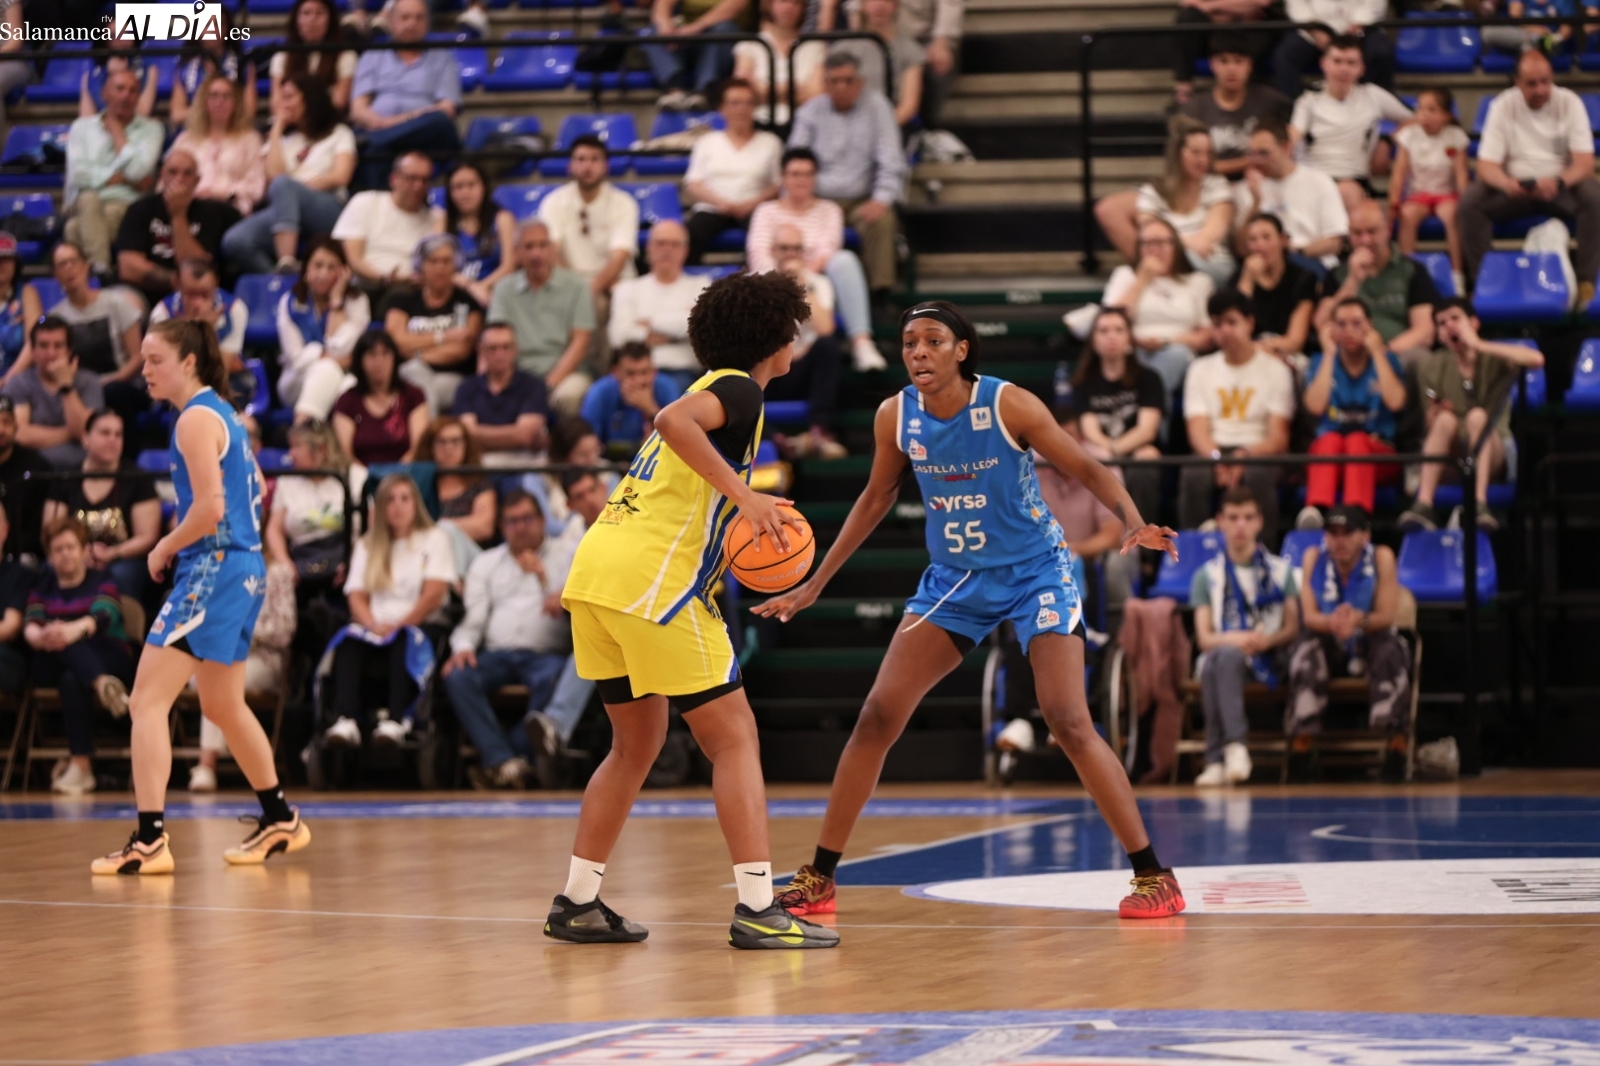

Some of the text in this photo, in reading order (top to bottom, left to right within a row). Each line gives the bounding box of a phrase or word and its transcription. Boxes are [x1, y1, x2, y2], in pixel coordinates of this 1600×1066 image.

[1217, 386, 1256, 420] W
[961, 463, 969, 473] Y
[943, 519, 987, 553] 55
